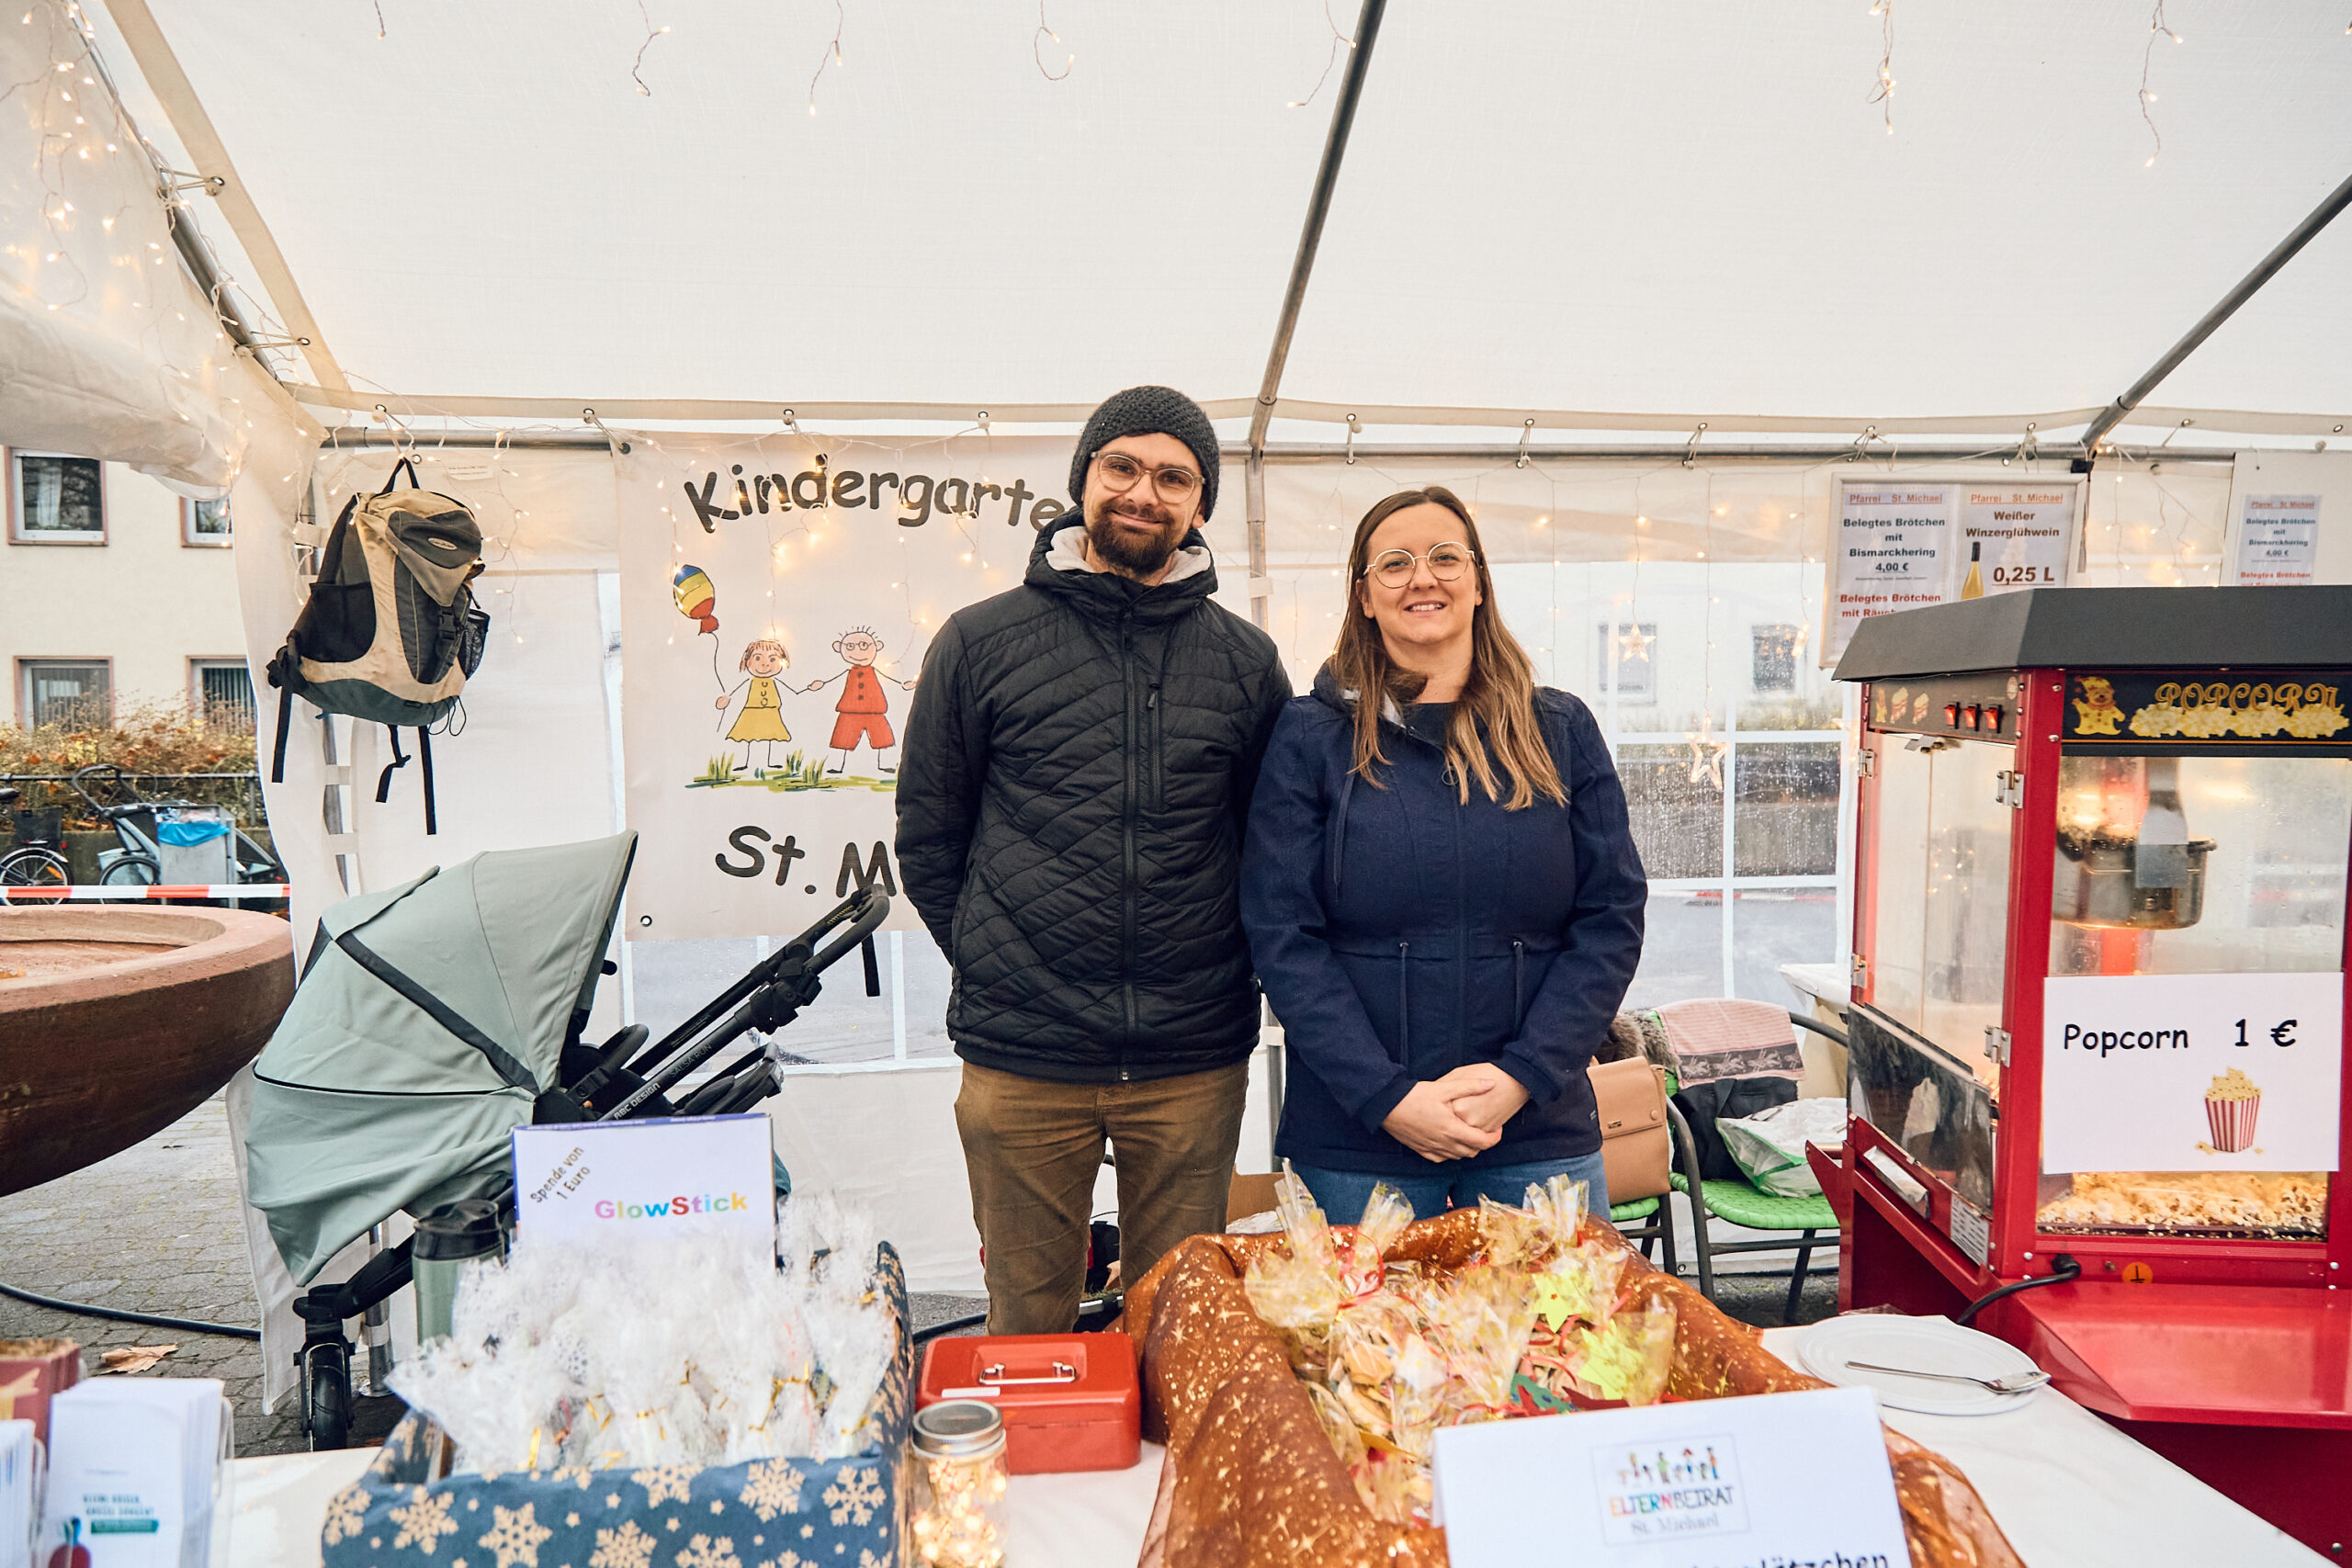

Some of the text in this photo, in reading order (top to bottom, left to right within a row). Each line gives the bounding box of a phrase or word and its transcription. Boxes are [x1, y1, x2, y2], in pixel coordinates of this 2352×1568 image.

[684, 454, 1066, 533] Kindergarte
[1849, 494, 1881, 502] Pfarrei
[1906, 494, 1942, 502] Michael
[1971, 493, 2001, 502] Pfarrei
[2028, 493, 2064, 502] Michael
[1994, 511, 2035, 521] Weißer
[1843, 518, 1945, 528] Belegtes Brötchen
[2246, 518, 2278, 526] Belegtes
[1885, 533, 1903, 542] mit
[1966, 527, 2060, 539] Winzerglühwein
[1849, 547, 1936, 558] Bismarckhering
[1875, 562, 1909, 573] 4,00 €
[1993, 567, 2054, 585] 0,25 L
[2240, 571, 2274, 580] Belegtes
[1840, 593, 1940, 604] Belegtes Brötchen
[1842, 609, 1860, 617] mit
[2154, 682, 2345, 712] POPCORN
[715, 825, 898, 897] St. M
[2064, 1019, 2297, 1058] Popcorn 1 €
[614, 1082, 661, 1120] ABC DESIGN
[530, 1146, 584, 1203] Spende von
[556, 1167, 591, 1200] 1 Euro
[594, 1192, 749, 1219] GlowStick
[1609, 1486, 1734, 1517] ELTERNBEIRAT
